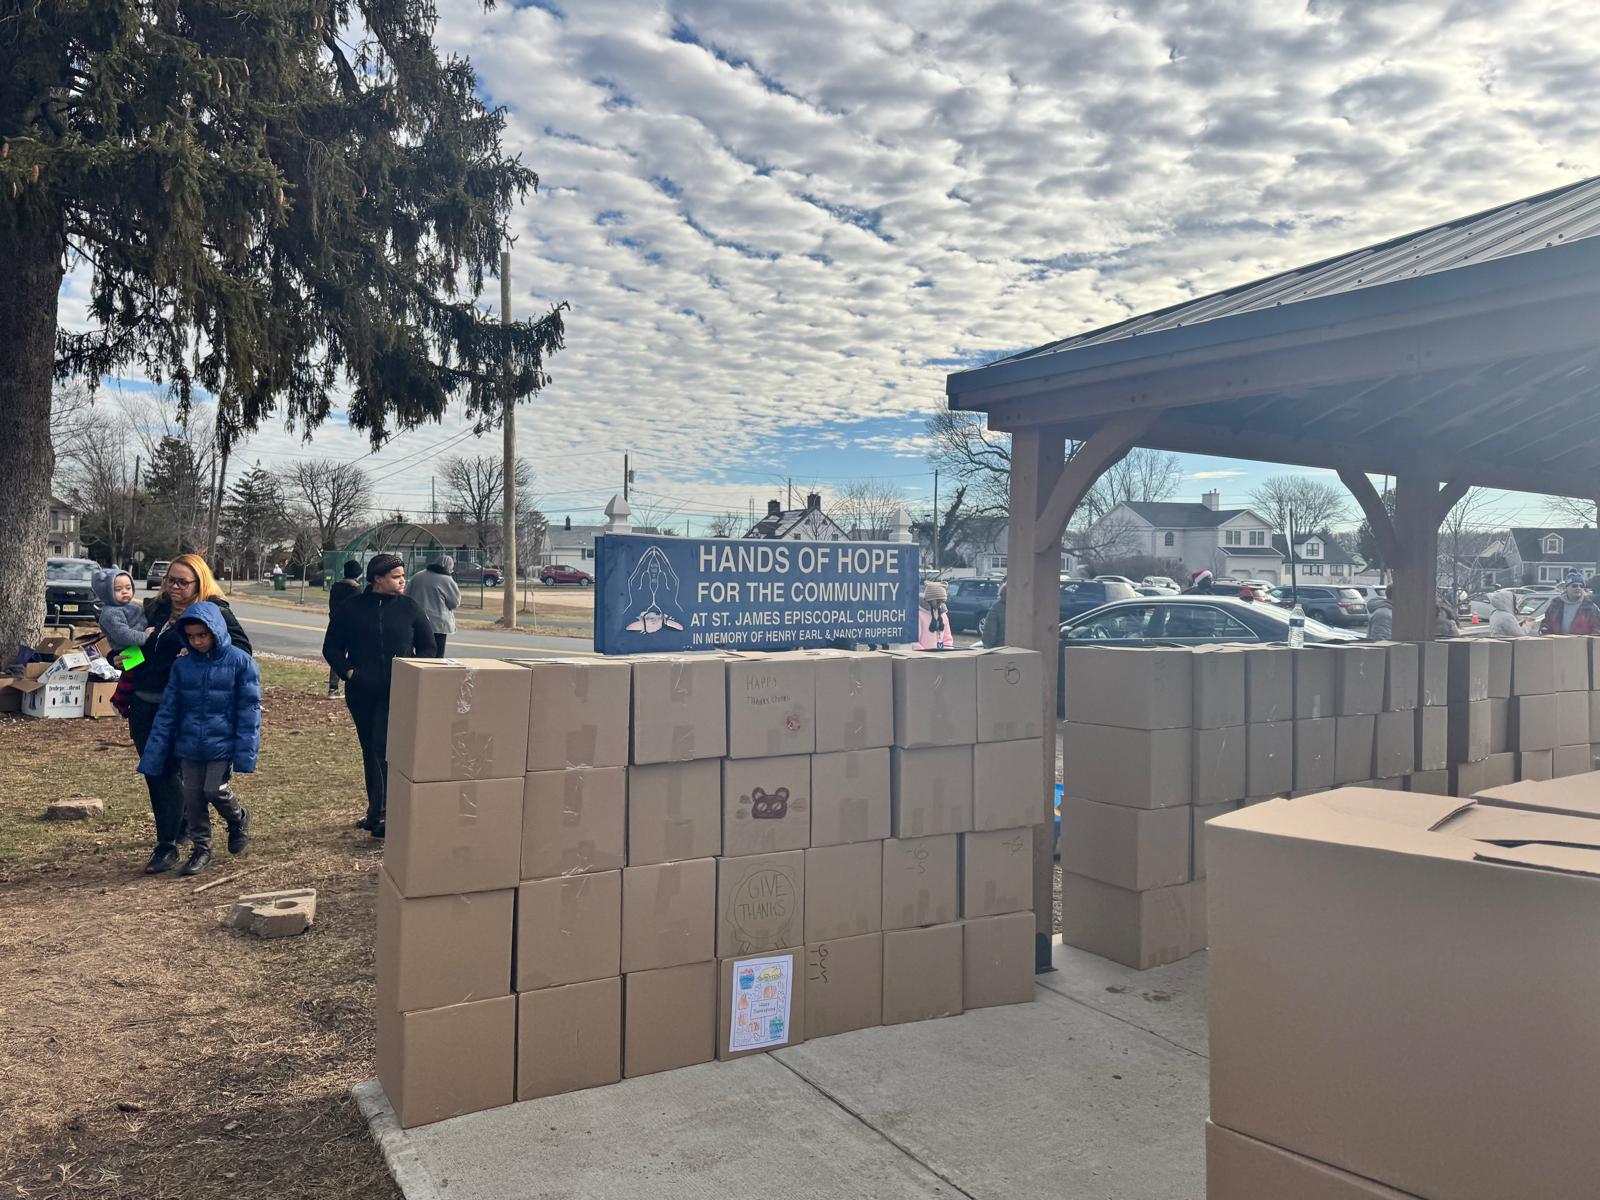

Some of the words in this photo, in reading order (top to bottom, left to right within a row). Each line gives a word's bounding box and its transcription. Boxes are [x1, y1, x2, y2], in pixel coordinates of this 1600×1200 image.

[700, 545, 790, 574] HANDS
[798, 546, 830, 574] OF
[838, 548, 899, 574] HOPE
[698, 582, 740, 603] FOR
[746, 582, 784, 602] THE
[791, 581, 900, 602] COMMUNITY
[690, 612, 708, 627] AT
[712, 612, 731, 626] ST.
[735, 611, 780, 626] JAMES
[784, 610, 854, 625] EPISCOPAL
[857, 609, 906, 623] CHURCH
[693, 633, 703, 644] IN
[705, 631, 748, 644] MEMORY
[750, 631, 764, 642] OF
[766, 629, 797, 642] HENRY
[799, 629, 823, 640] EARL
[825, 629, 832, 639] &
[833, 628, 863, 639] NANCY
[865, 627, 903, 637] RUPPERT
[748, 872, 788, 899] GIVE
[737, 900, 786, 921] THANKS
